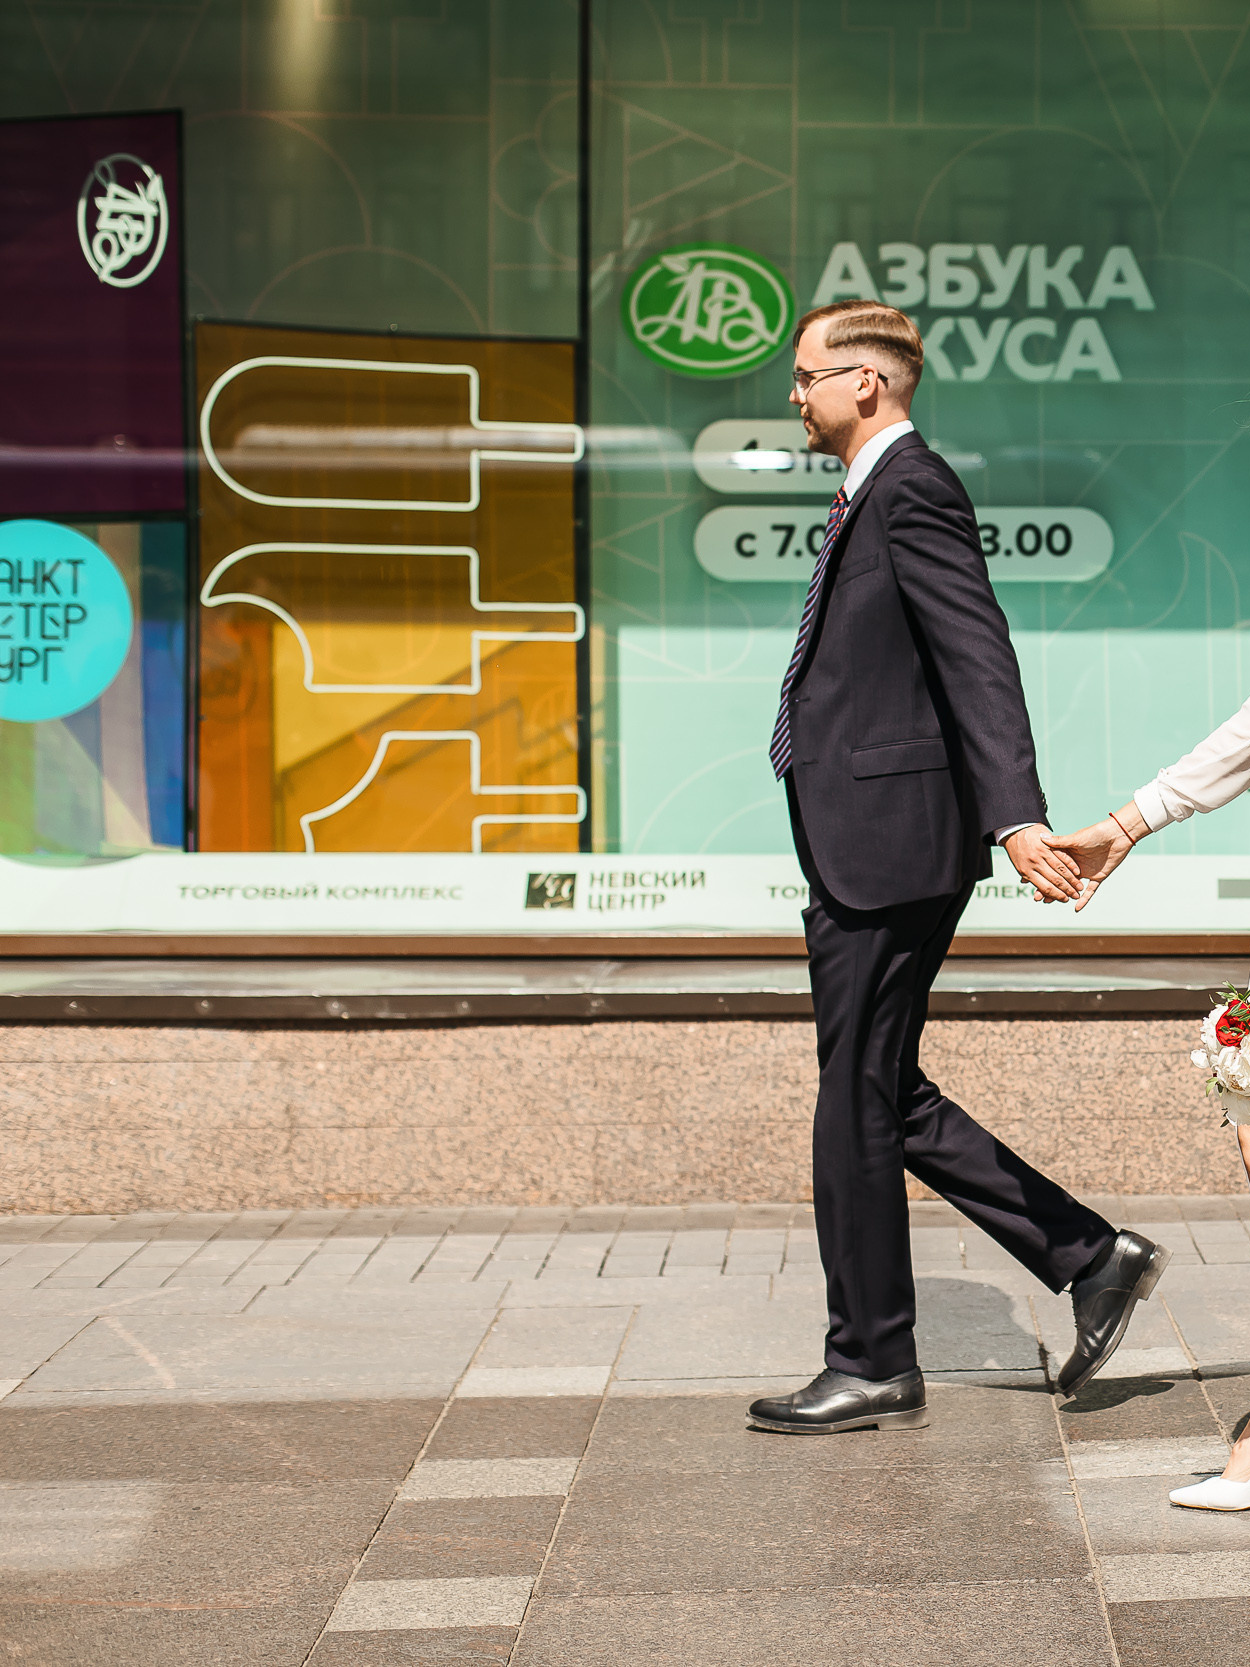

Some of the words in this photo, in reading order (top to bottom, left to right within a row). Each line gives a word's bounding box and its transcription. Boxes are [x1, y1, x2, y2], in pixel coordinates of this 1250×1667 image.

[811, 242, 1156, 310] АЗБУКА
[910, 316, 1123, 382] КУСА
[734, 532, 757, 558] с
[770, 523, 828, 558] 7.0
[978, 522, 1073, 557] 3.00
[0, 558, 86, 596] АНКТ
[0, 602, 88, 640] ЕТЕР
[0, 646, 63, 684] УРГ
[177, 883, 319, 900] ТОРГОВЫЙ
[325, 885, 464, 901] КОМПЛЕКС
[588, 870, 706, 889] НЕВСКИЙ
[587, 893, 666, 912] ЦЕНТР
